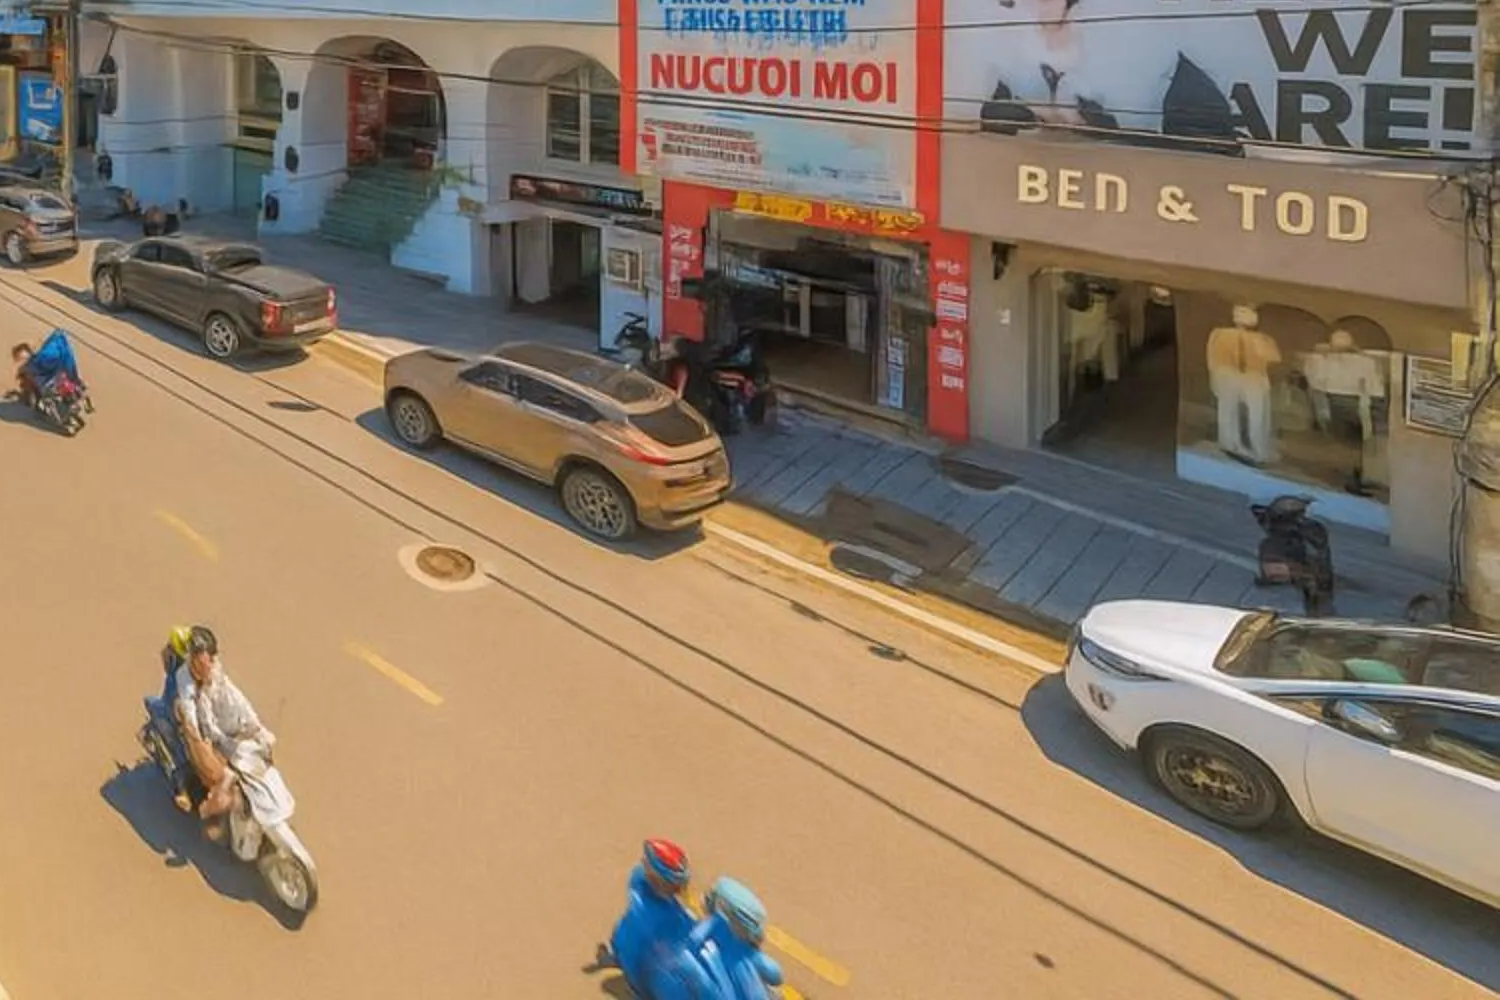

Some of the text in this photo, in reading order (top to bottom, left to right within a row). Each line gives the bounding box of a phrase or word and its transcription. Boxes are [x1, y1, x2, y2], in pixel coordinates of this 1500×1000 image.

[1256, 7, 1478, 80] WE
[1156, 185, 1200, 223] &
[1227, 183, 1369, 242] TOD
